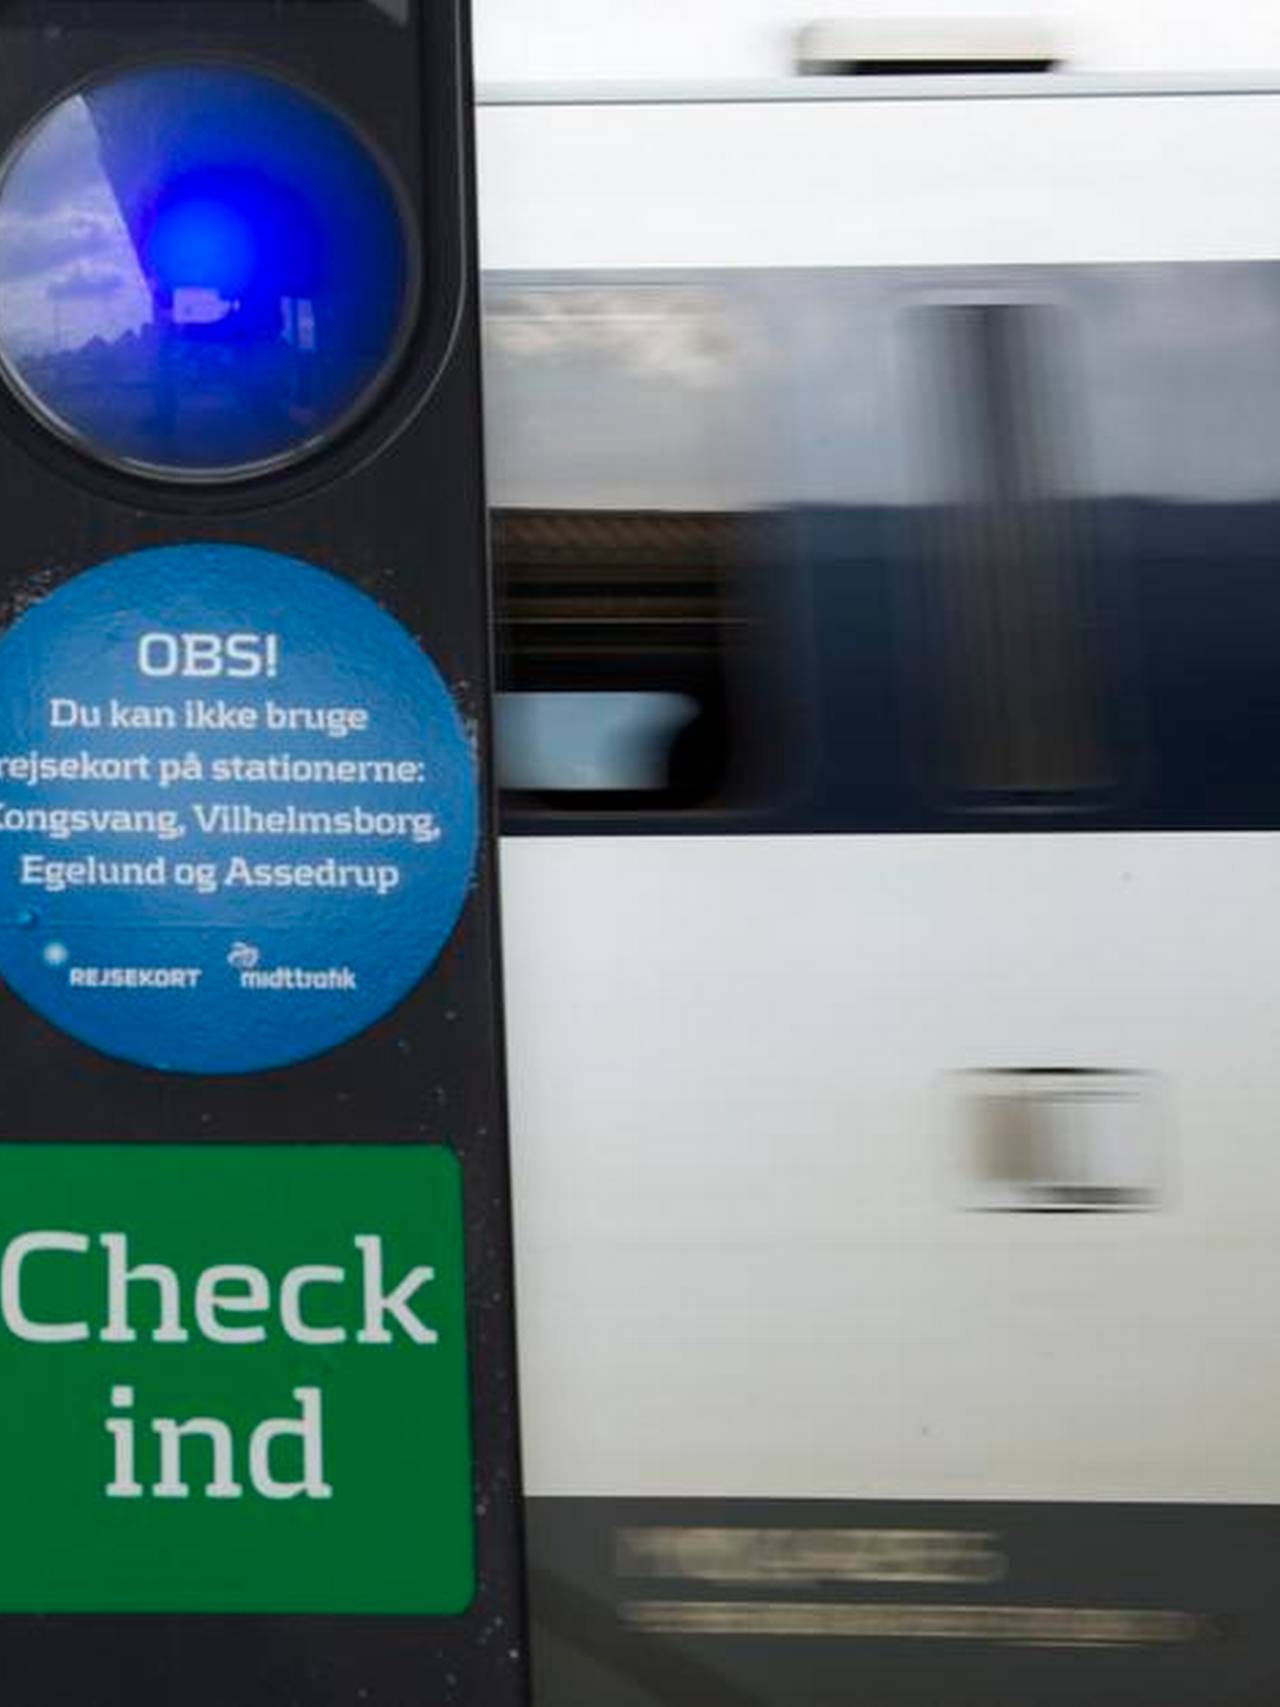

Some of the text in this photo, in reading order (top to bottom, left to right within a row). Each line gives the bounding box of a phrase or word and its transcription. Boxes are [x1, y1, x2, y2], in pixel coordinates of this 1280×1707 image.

[138, 632, 279, 678] OBS!
[50, 698, 368, 738] Du kan ikke bruge
[159, 752, 203, 787] på
[210, 753, 426, 783] stationerne:
[191, 803, 441, 843] Vilhelmsborg,
[21, 855, 399, 895] Egelund og Assedrup
[69, 967, 202, 988] REJSEKORT
[240, 965, 357, 990] midttrafik
[0, 1230, 439, 1344] Check
[105, 1385, 331, 1499] ind
